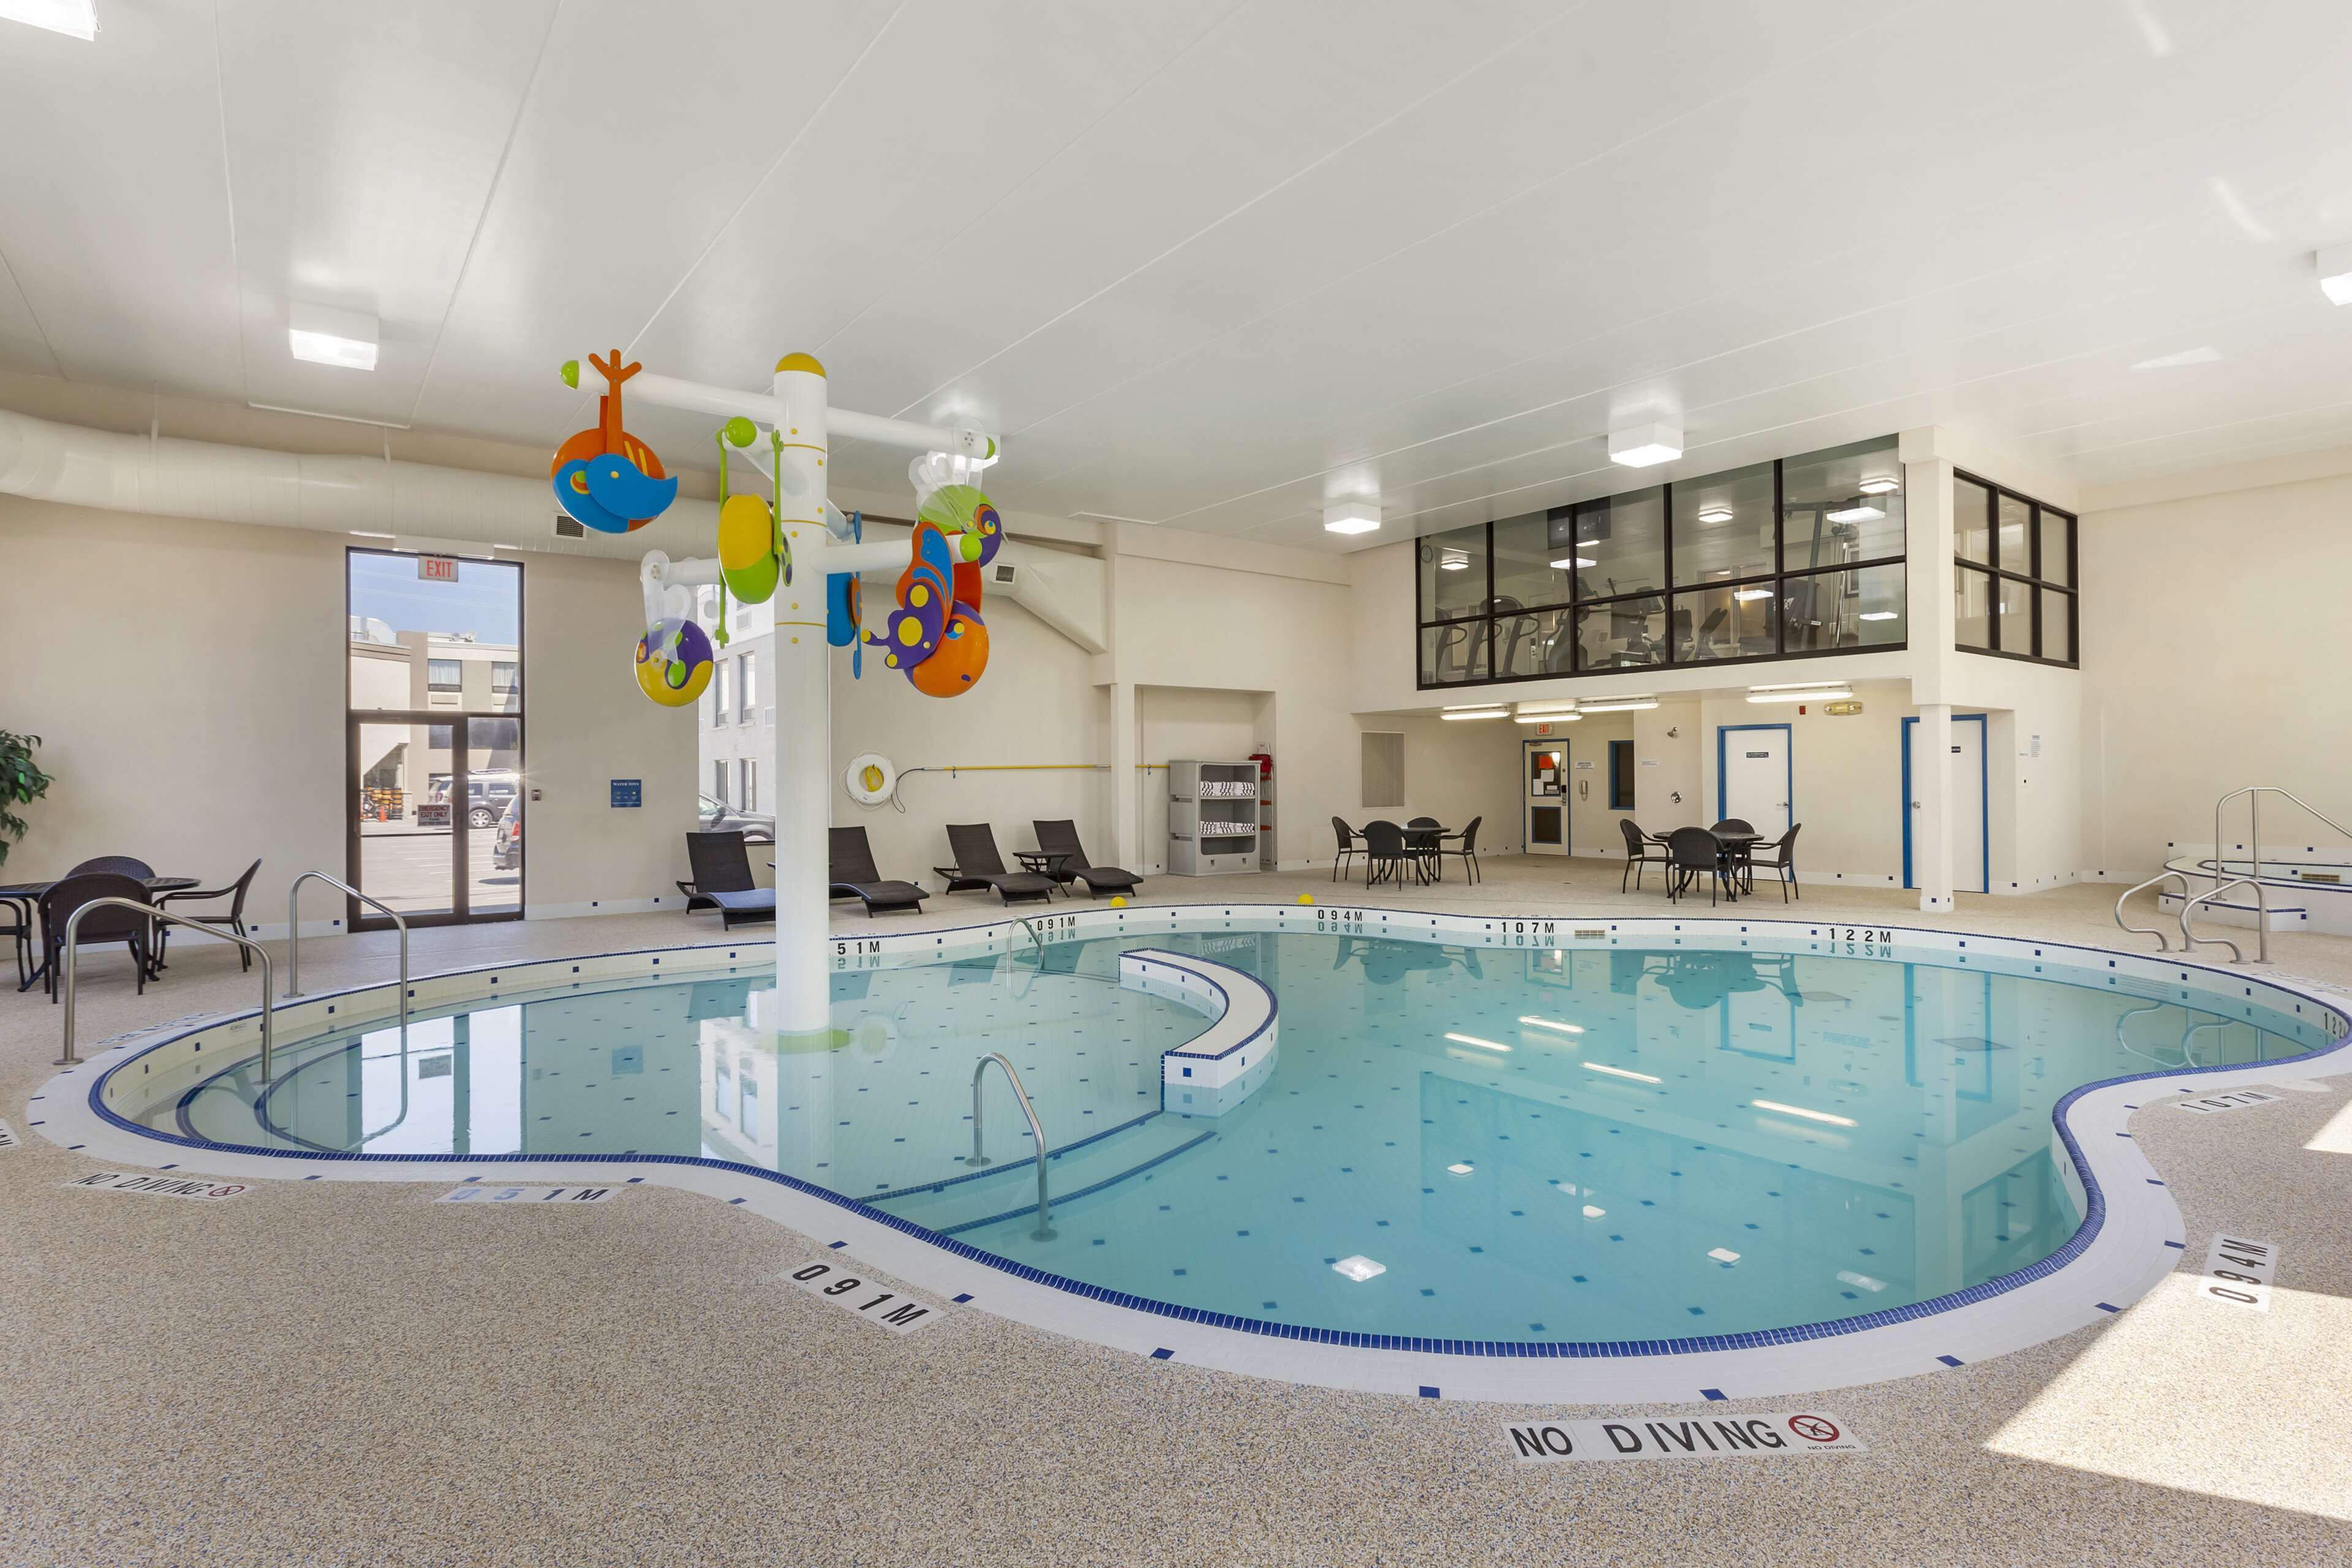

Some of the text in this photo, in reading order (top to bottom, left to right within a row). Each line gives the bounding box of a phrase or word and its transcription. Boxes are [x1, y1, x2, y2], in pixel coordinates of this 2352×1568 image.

[426, 559, 452, 578] EXIT
[1539, 724, 1549, 734] EXIT
[70, 1173, 214, 1195] NO DIVING
[1510, 1418, 1788, 1457] NO DIVING
